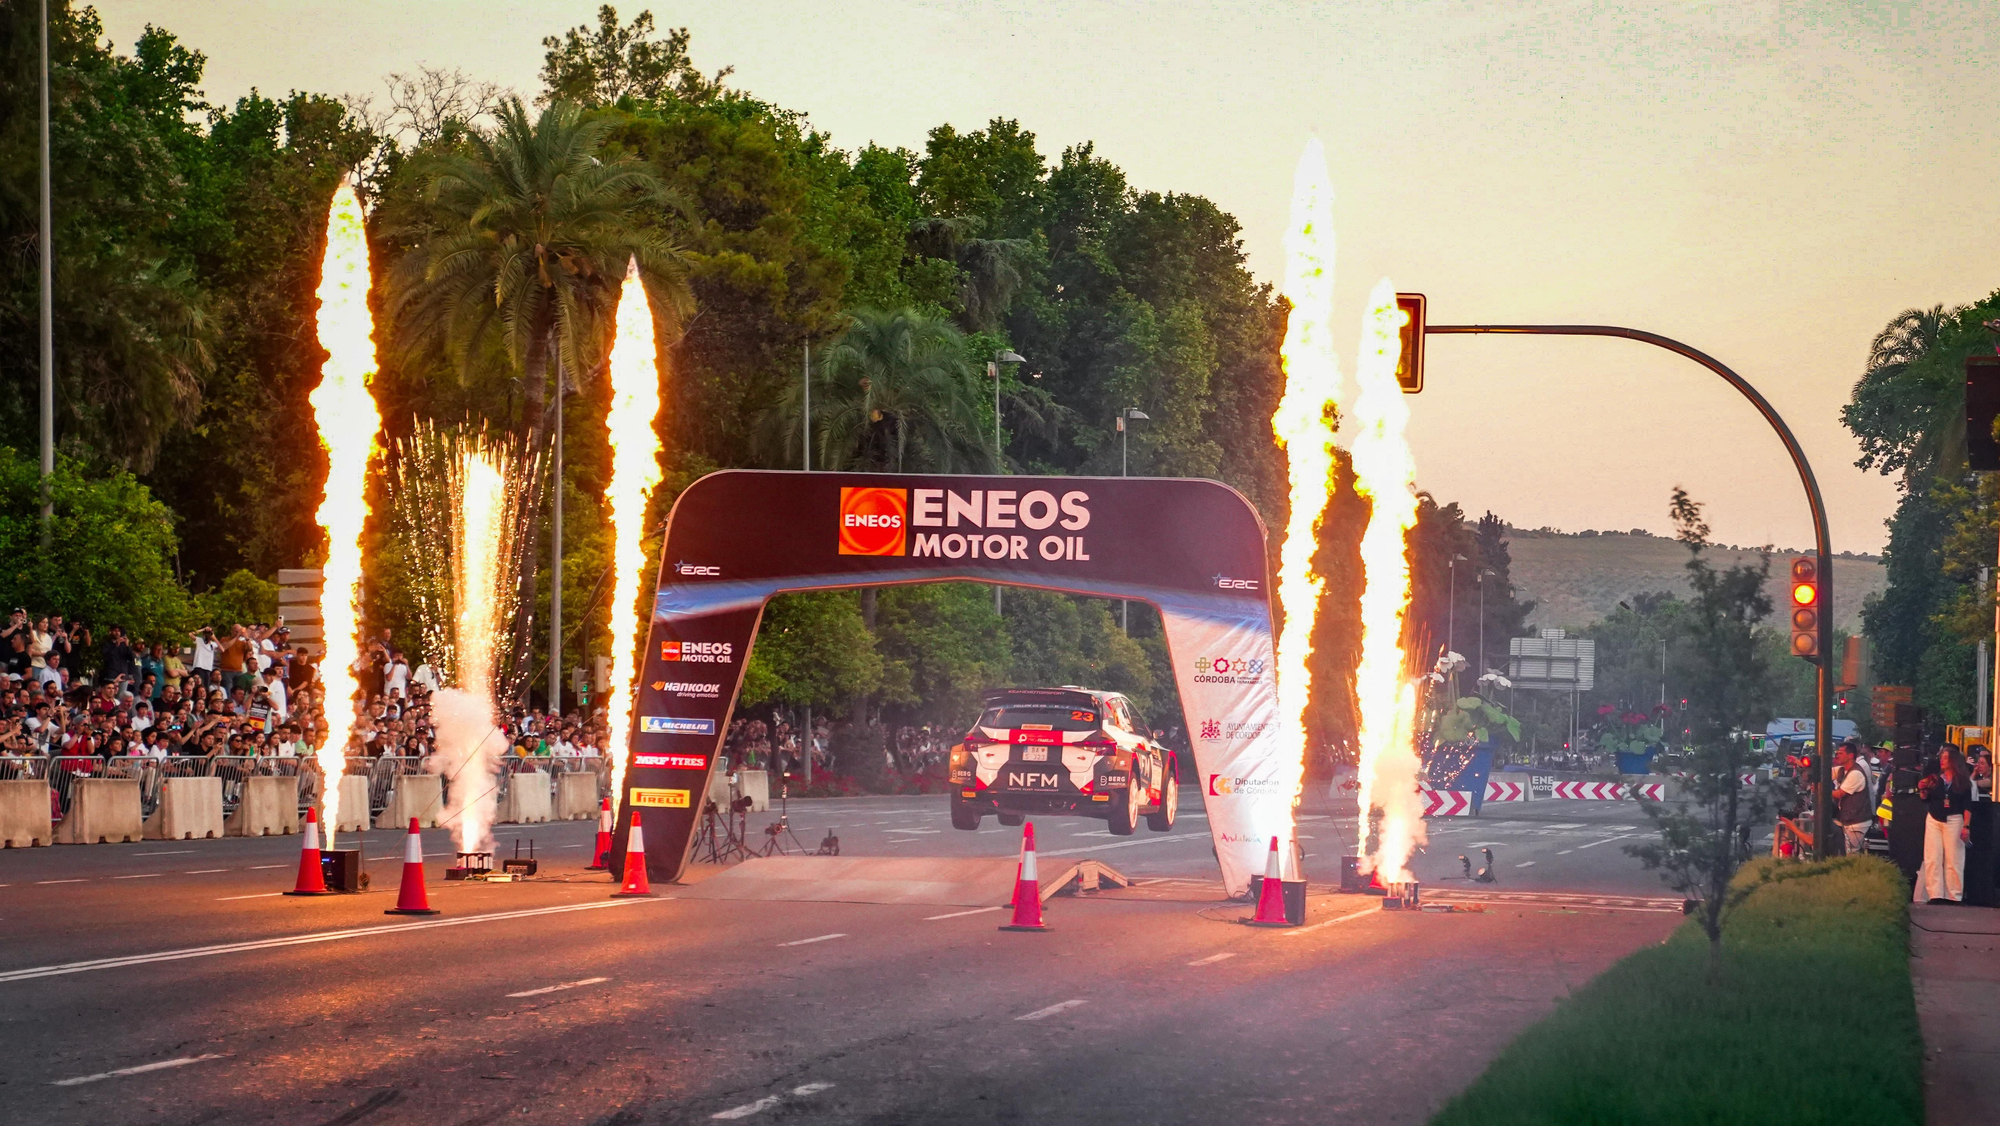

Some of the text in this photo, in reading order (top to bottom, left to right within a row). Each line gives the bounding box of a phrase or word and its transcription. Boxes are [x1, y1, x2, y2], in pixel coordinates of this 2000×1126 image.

[912, 488, 1091, 531] ENEOS
[844, 514, 901, 528] ENEOS
[912, 533, 1090, 561] MOTOR OIL
[680, 566, 721, 576] ERC
[1218, 579, 1259, 590] ERC
[681, 642, 732, 655] ENEOS
[681, 654, 732, 663] MOTOR OIL
[1193, 674, 1236, 684] CÓRDOBA
[1070, 710, 1095, 722] 23
[661, 722, 709, 731] MICHELIN
[1225, 731, 1235, 739] DE
[634, 755, 704, 767] MRF TYRES
[1008, 772, 1058, 788] NFM
[636, 791, 685, 805] PIRELLI
